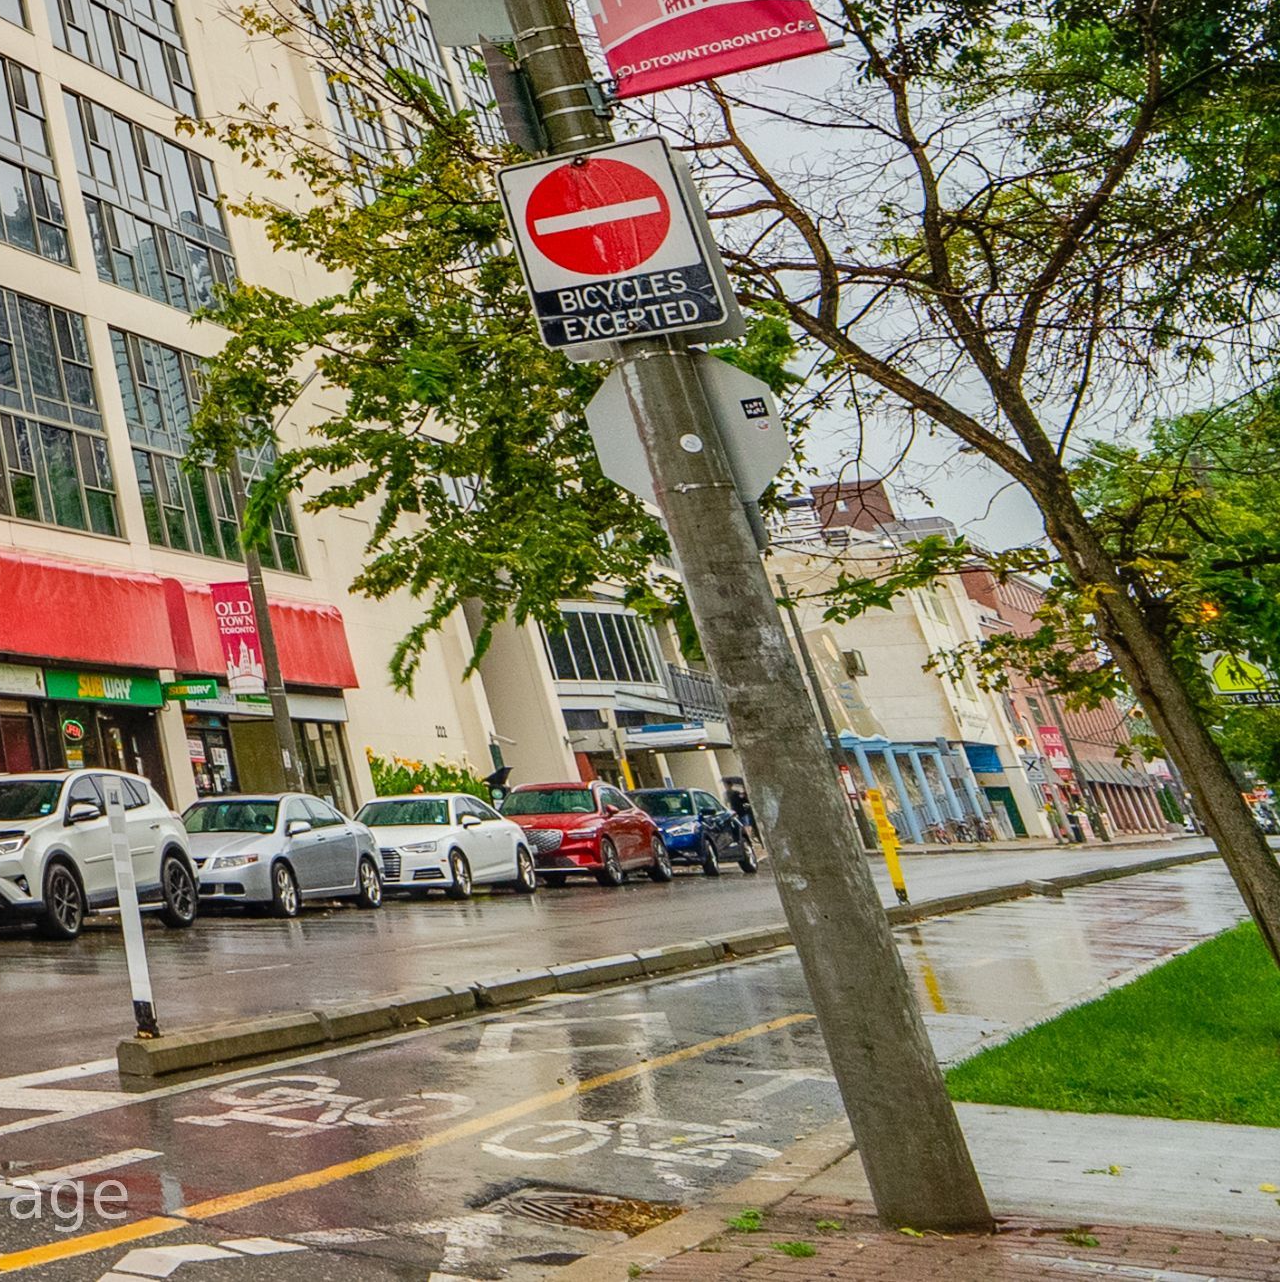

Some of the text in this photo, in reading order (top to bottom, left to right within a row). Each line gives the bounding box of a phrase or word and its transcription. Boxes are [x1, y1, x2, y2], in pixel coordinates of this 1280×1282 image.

[617, 21, 809, 77] OLDTOWNTORONTO.CA
[557, 271, 687, 313] BICYCLES
[563, 299, 700, 341] EXCEPTED
[214, 601, 252, 616] OLD
[216, 614, 254, 627] TOWN
[219, 626, 256, 635] TORONTO
[78, 675, 132, 700] SUBWAY
[168, 683, 212, 696] SUBWAY
[65, 723, 81, 738] OPEN
